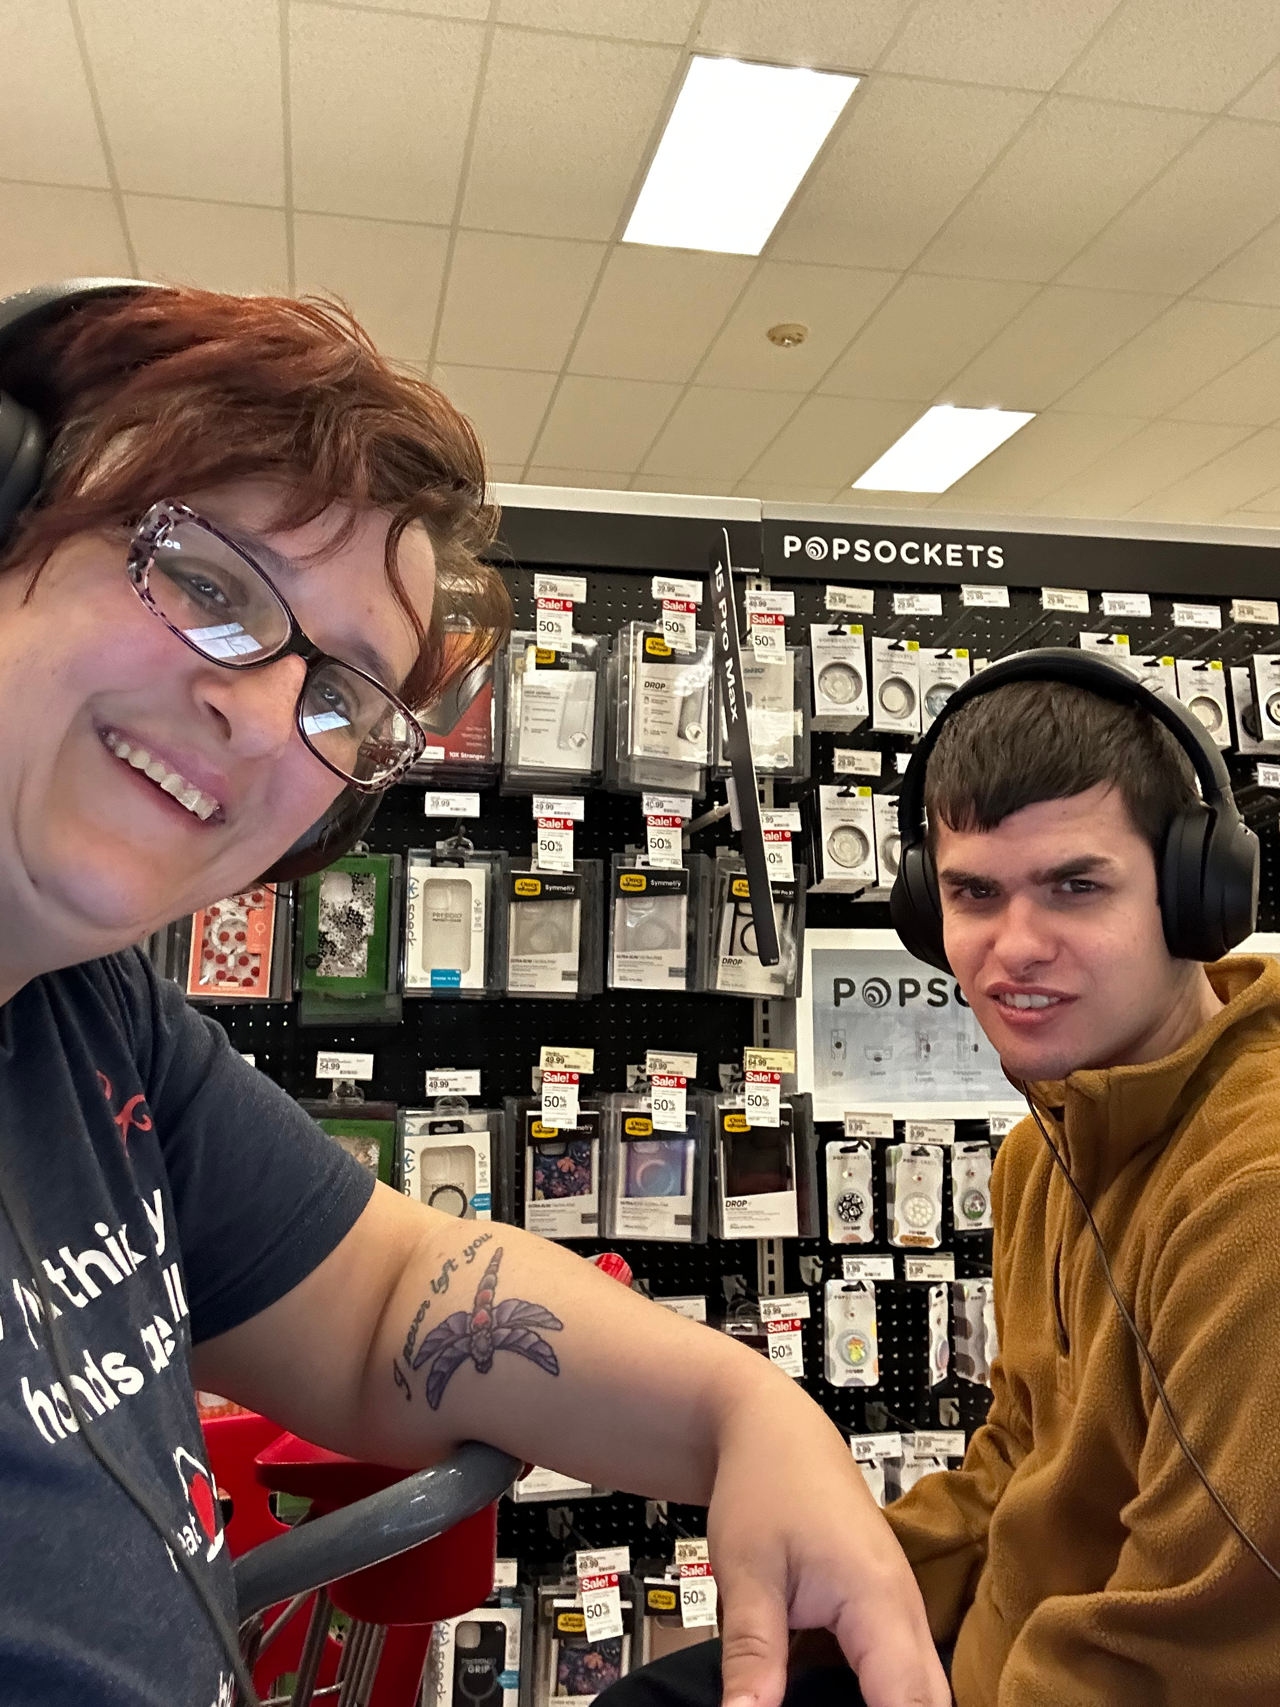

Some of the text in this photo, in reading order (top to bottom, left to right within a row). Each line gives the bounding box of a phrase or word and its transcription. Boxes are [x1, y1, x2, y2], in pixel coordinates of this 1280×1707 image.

[784, 535, 1004, 569] POPSOCKETS
[537, 599, 564, 610] Sale!
[662, 600, 687, 611] Sale!
[751, 614, 776, 624] Sale!
[718, 597, 730, 652] Pro
[725, 657, 739, 724] Max
[538, 818, 564, 829] Sale!
[647, 816, 673, 827] Sale!
[545, 884, 576, 893] Symmetry
[650, 880, 682, 889] Symmetry
[319, 1062, 340, 1071] 54.99
[543, 1072, 570, 1083] Sale!
[652, 1075, 678, 1087] Sale!
[745, 1071, 772, 1083] Sale!
[428, 1080, 449, 1089] 49.99
[41, 1221, 148, 1309] thik
[429, 1257, 460, 1295] left
[462, 1232, 494, 1265] you
[767, 1322, 793, 1333] Sale!
[680, 1564, 707, 1577] Sale!
[581, 1576, 609, 1591] Sale!
[467, 1664, 491, 1674] GRIP
